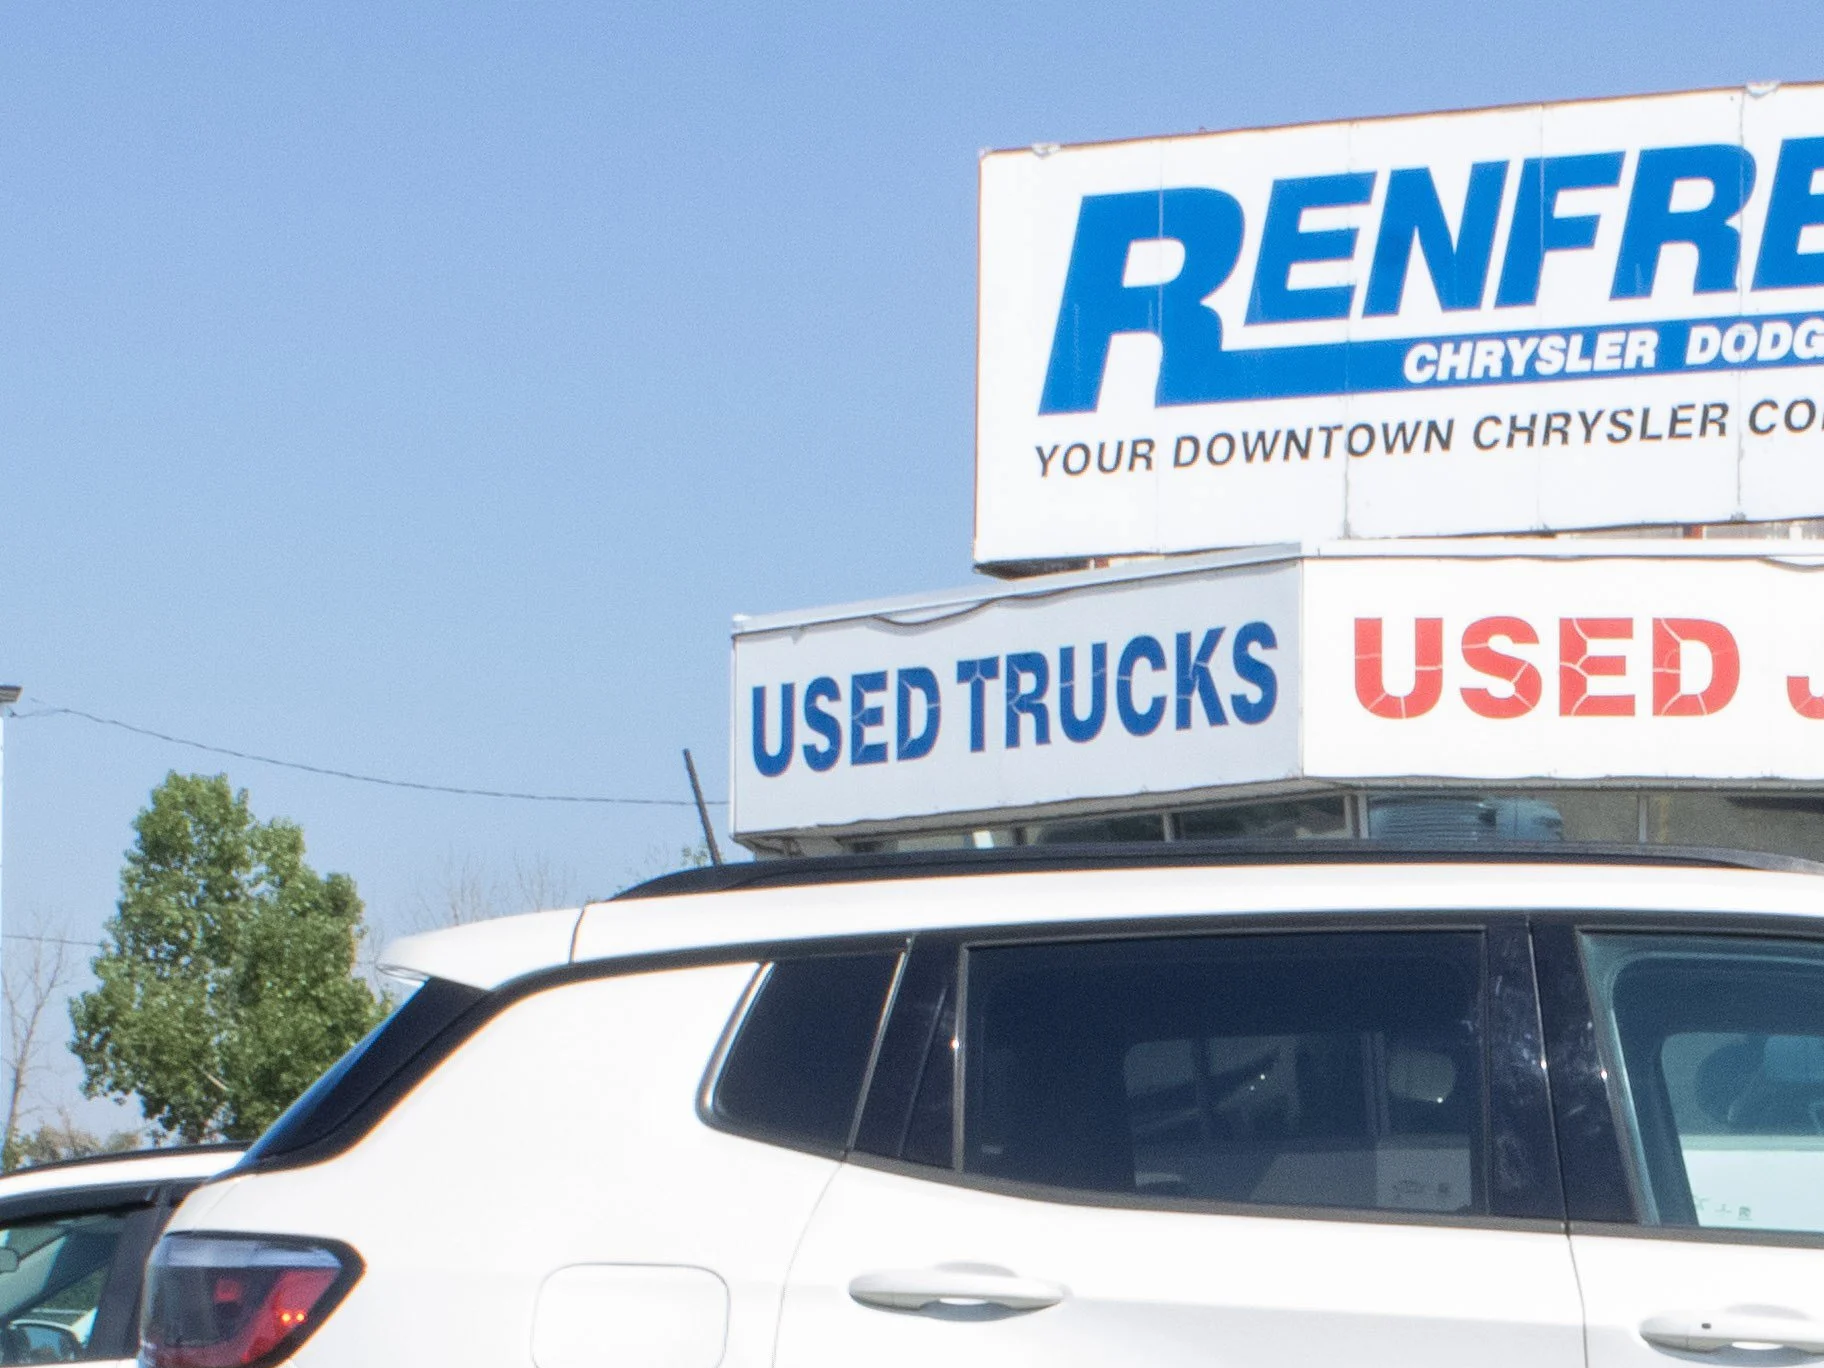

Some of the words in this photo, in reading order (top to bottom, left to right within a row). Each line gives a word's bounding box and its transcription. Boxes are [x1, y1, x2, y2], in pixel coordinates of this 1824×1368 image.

[1403, 327, 1661, 385] CHRYSLER
[1034, 438, 1156, 477] YOUR
[1172, 419, 1455, 469] DOWNTOWN
[1472, 400, 1730, 450] CHRYSLER
[751, 666, 942, 778] USED
[956, 620, 1279, 752] TRUCKS
[1354, 615, 1741, 720] USED
